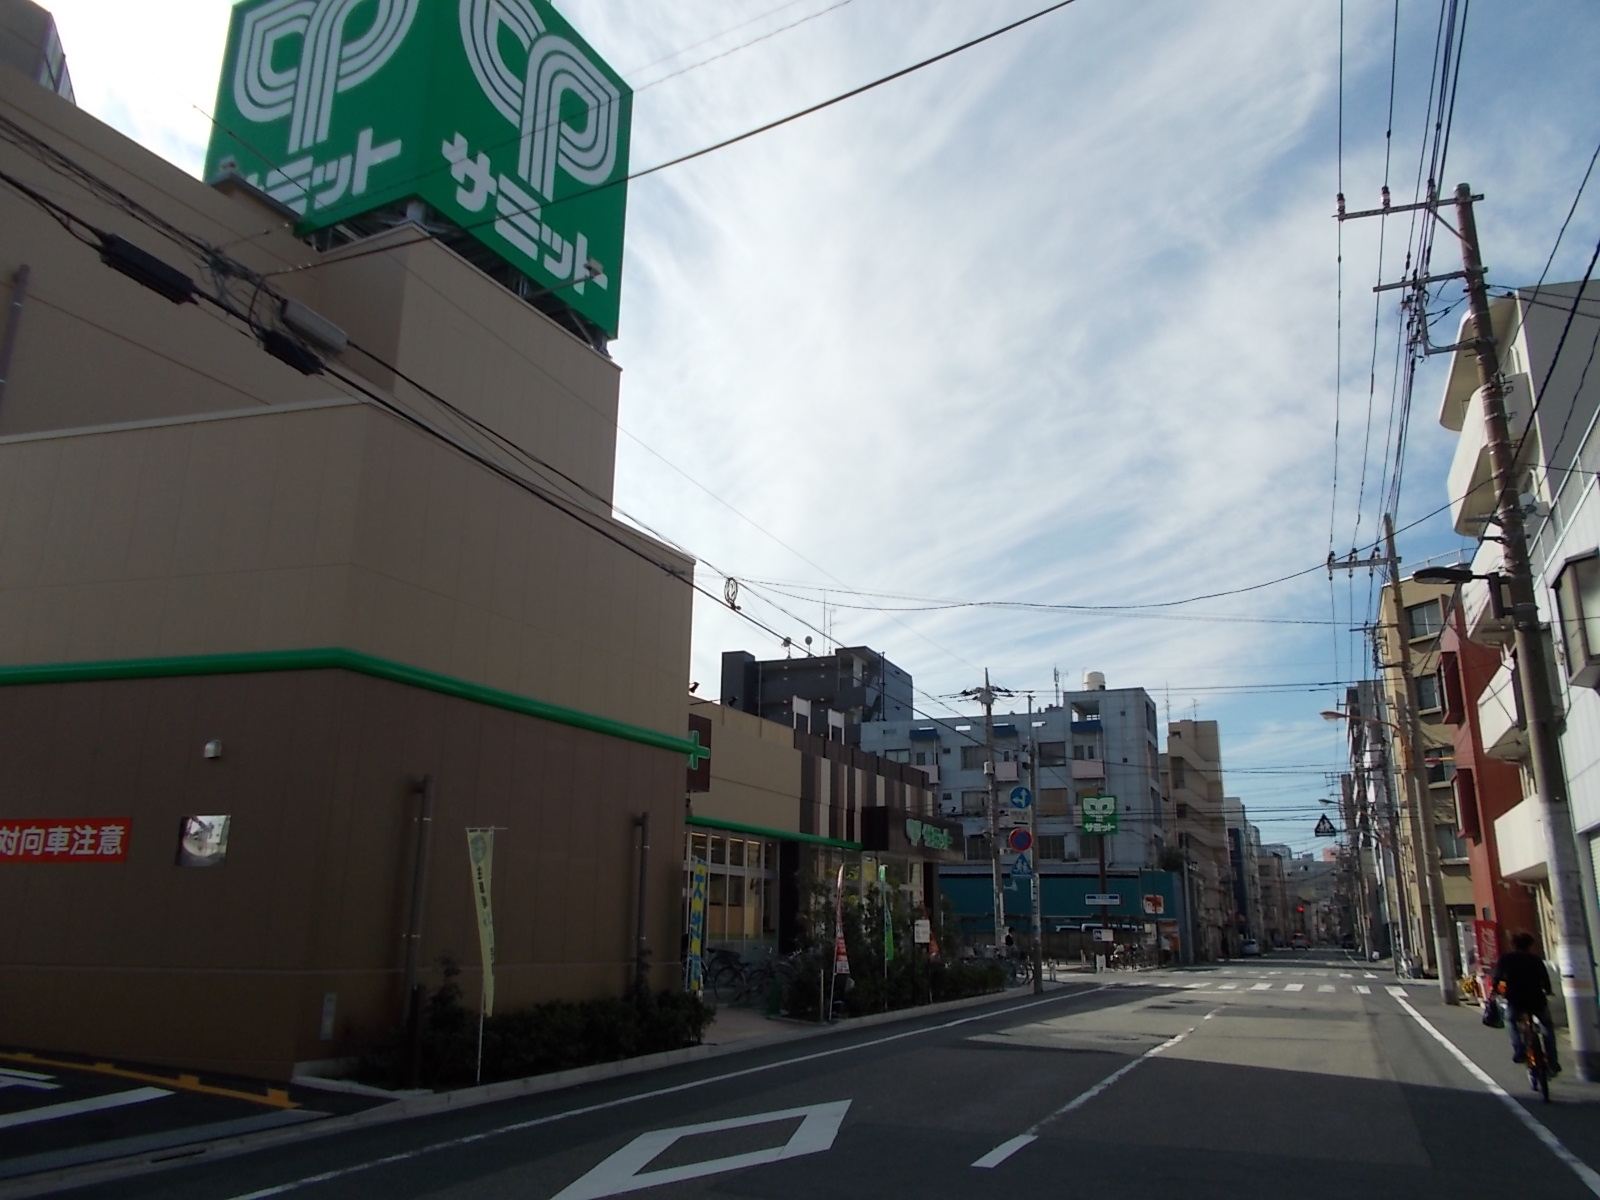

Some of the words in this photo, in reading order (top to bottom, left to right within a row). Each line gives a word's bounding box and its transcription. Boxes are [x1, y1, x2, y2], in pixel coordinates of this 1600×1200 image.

[246, 129, 401, 215] ミット
[442, 131, 608, 295] サミット
[0, 825, 124, 855] 対向車注意
